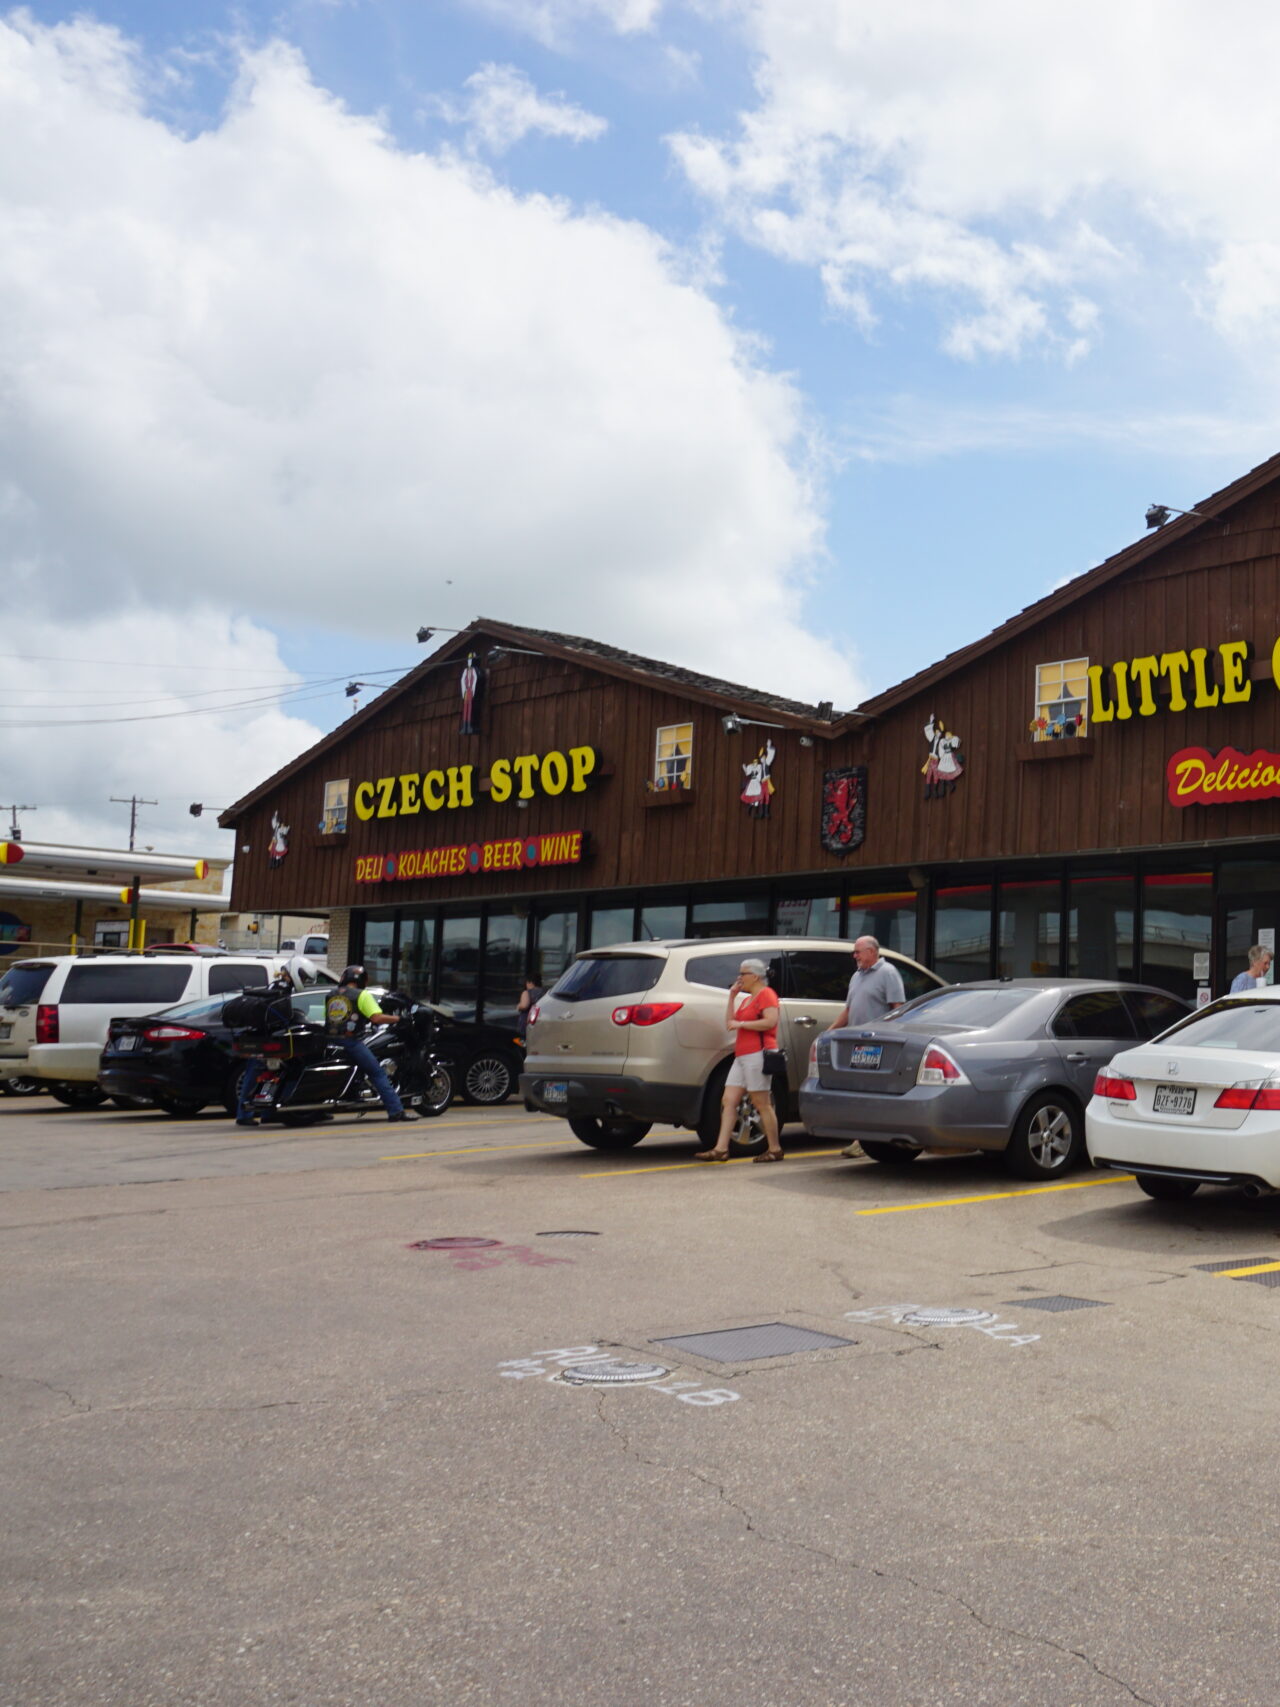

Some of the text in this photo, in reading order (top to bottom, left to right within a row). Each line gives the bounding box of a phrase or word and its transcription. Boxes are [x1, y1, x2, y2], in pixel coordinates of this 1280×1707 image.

[1085, 640, 1252, 724] LITTLE
[354, 745, 597, 822] CZECH STOP
[356, 833, 581, 880] DELI KOLACHES BEER WINE
